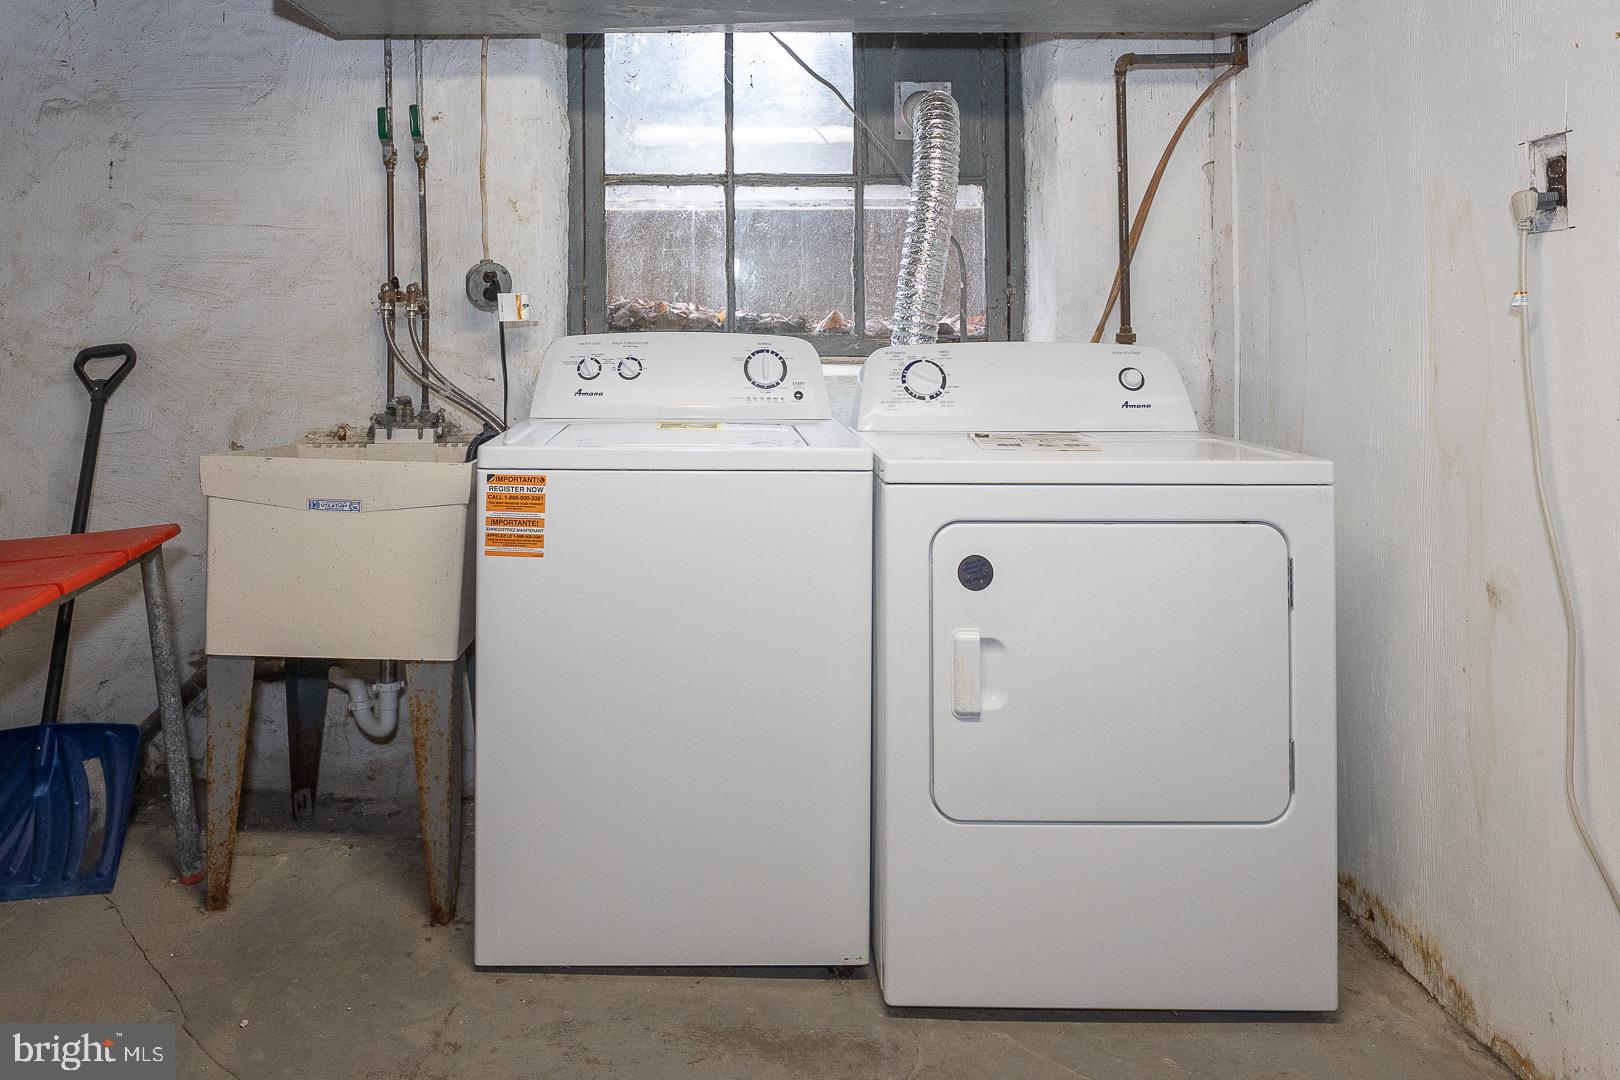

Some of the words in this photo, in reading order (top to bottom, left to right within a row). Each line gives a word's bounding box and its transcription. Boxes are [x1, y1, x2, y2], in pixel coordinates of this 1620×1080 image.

[574, 388, 604, 397] Amana
[1121, 400, 1152, 409] Amana
[495, 475, 539, 483] IMPORTANT!
[488, 485, 525, 493] REGISTER
[490, 518, 540, 527] IMPORTANTE!
